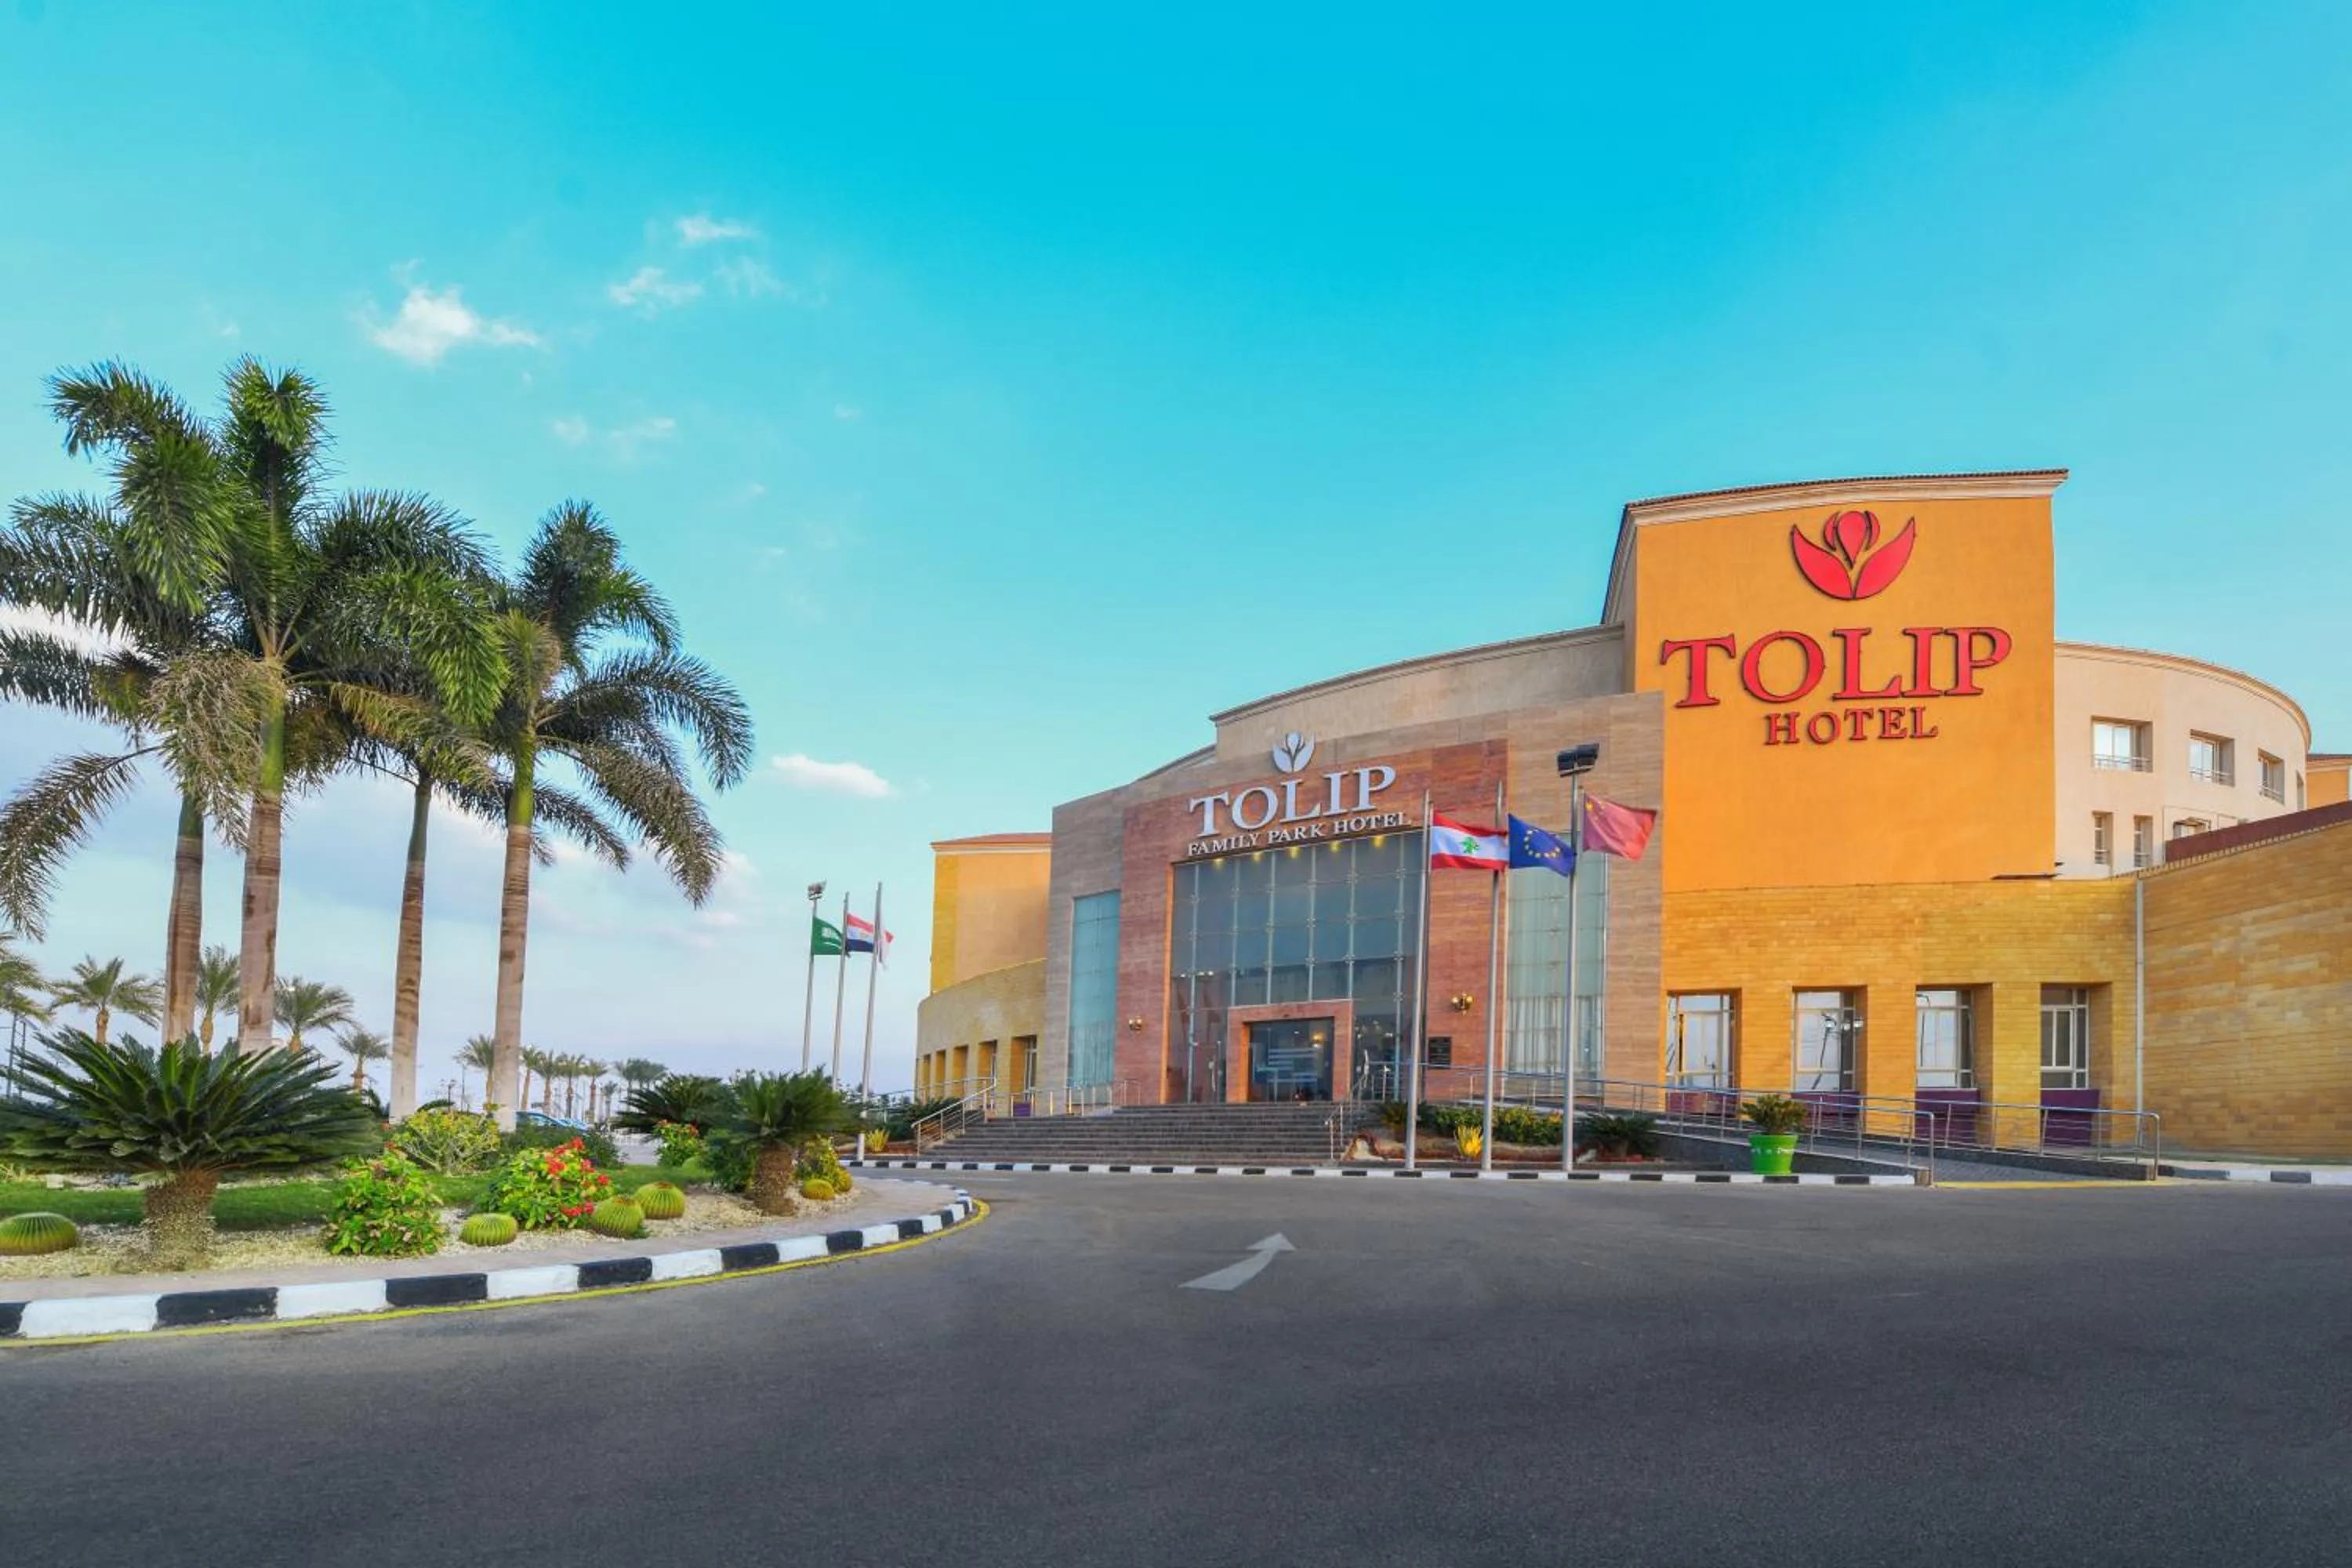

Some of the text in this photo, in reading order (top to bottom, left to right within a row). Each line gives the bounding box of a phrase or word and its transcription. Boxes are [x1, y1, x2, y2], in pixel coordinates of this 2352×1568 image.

[1660, 627, 2012, 708] TOLIP
[1764, 706, 1938, 745] HOTEL
[1189, 765, 1396, 837] TOLIP
[1188, 811, 1410, 857] FAMILY PARK HOTEL
